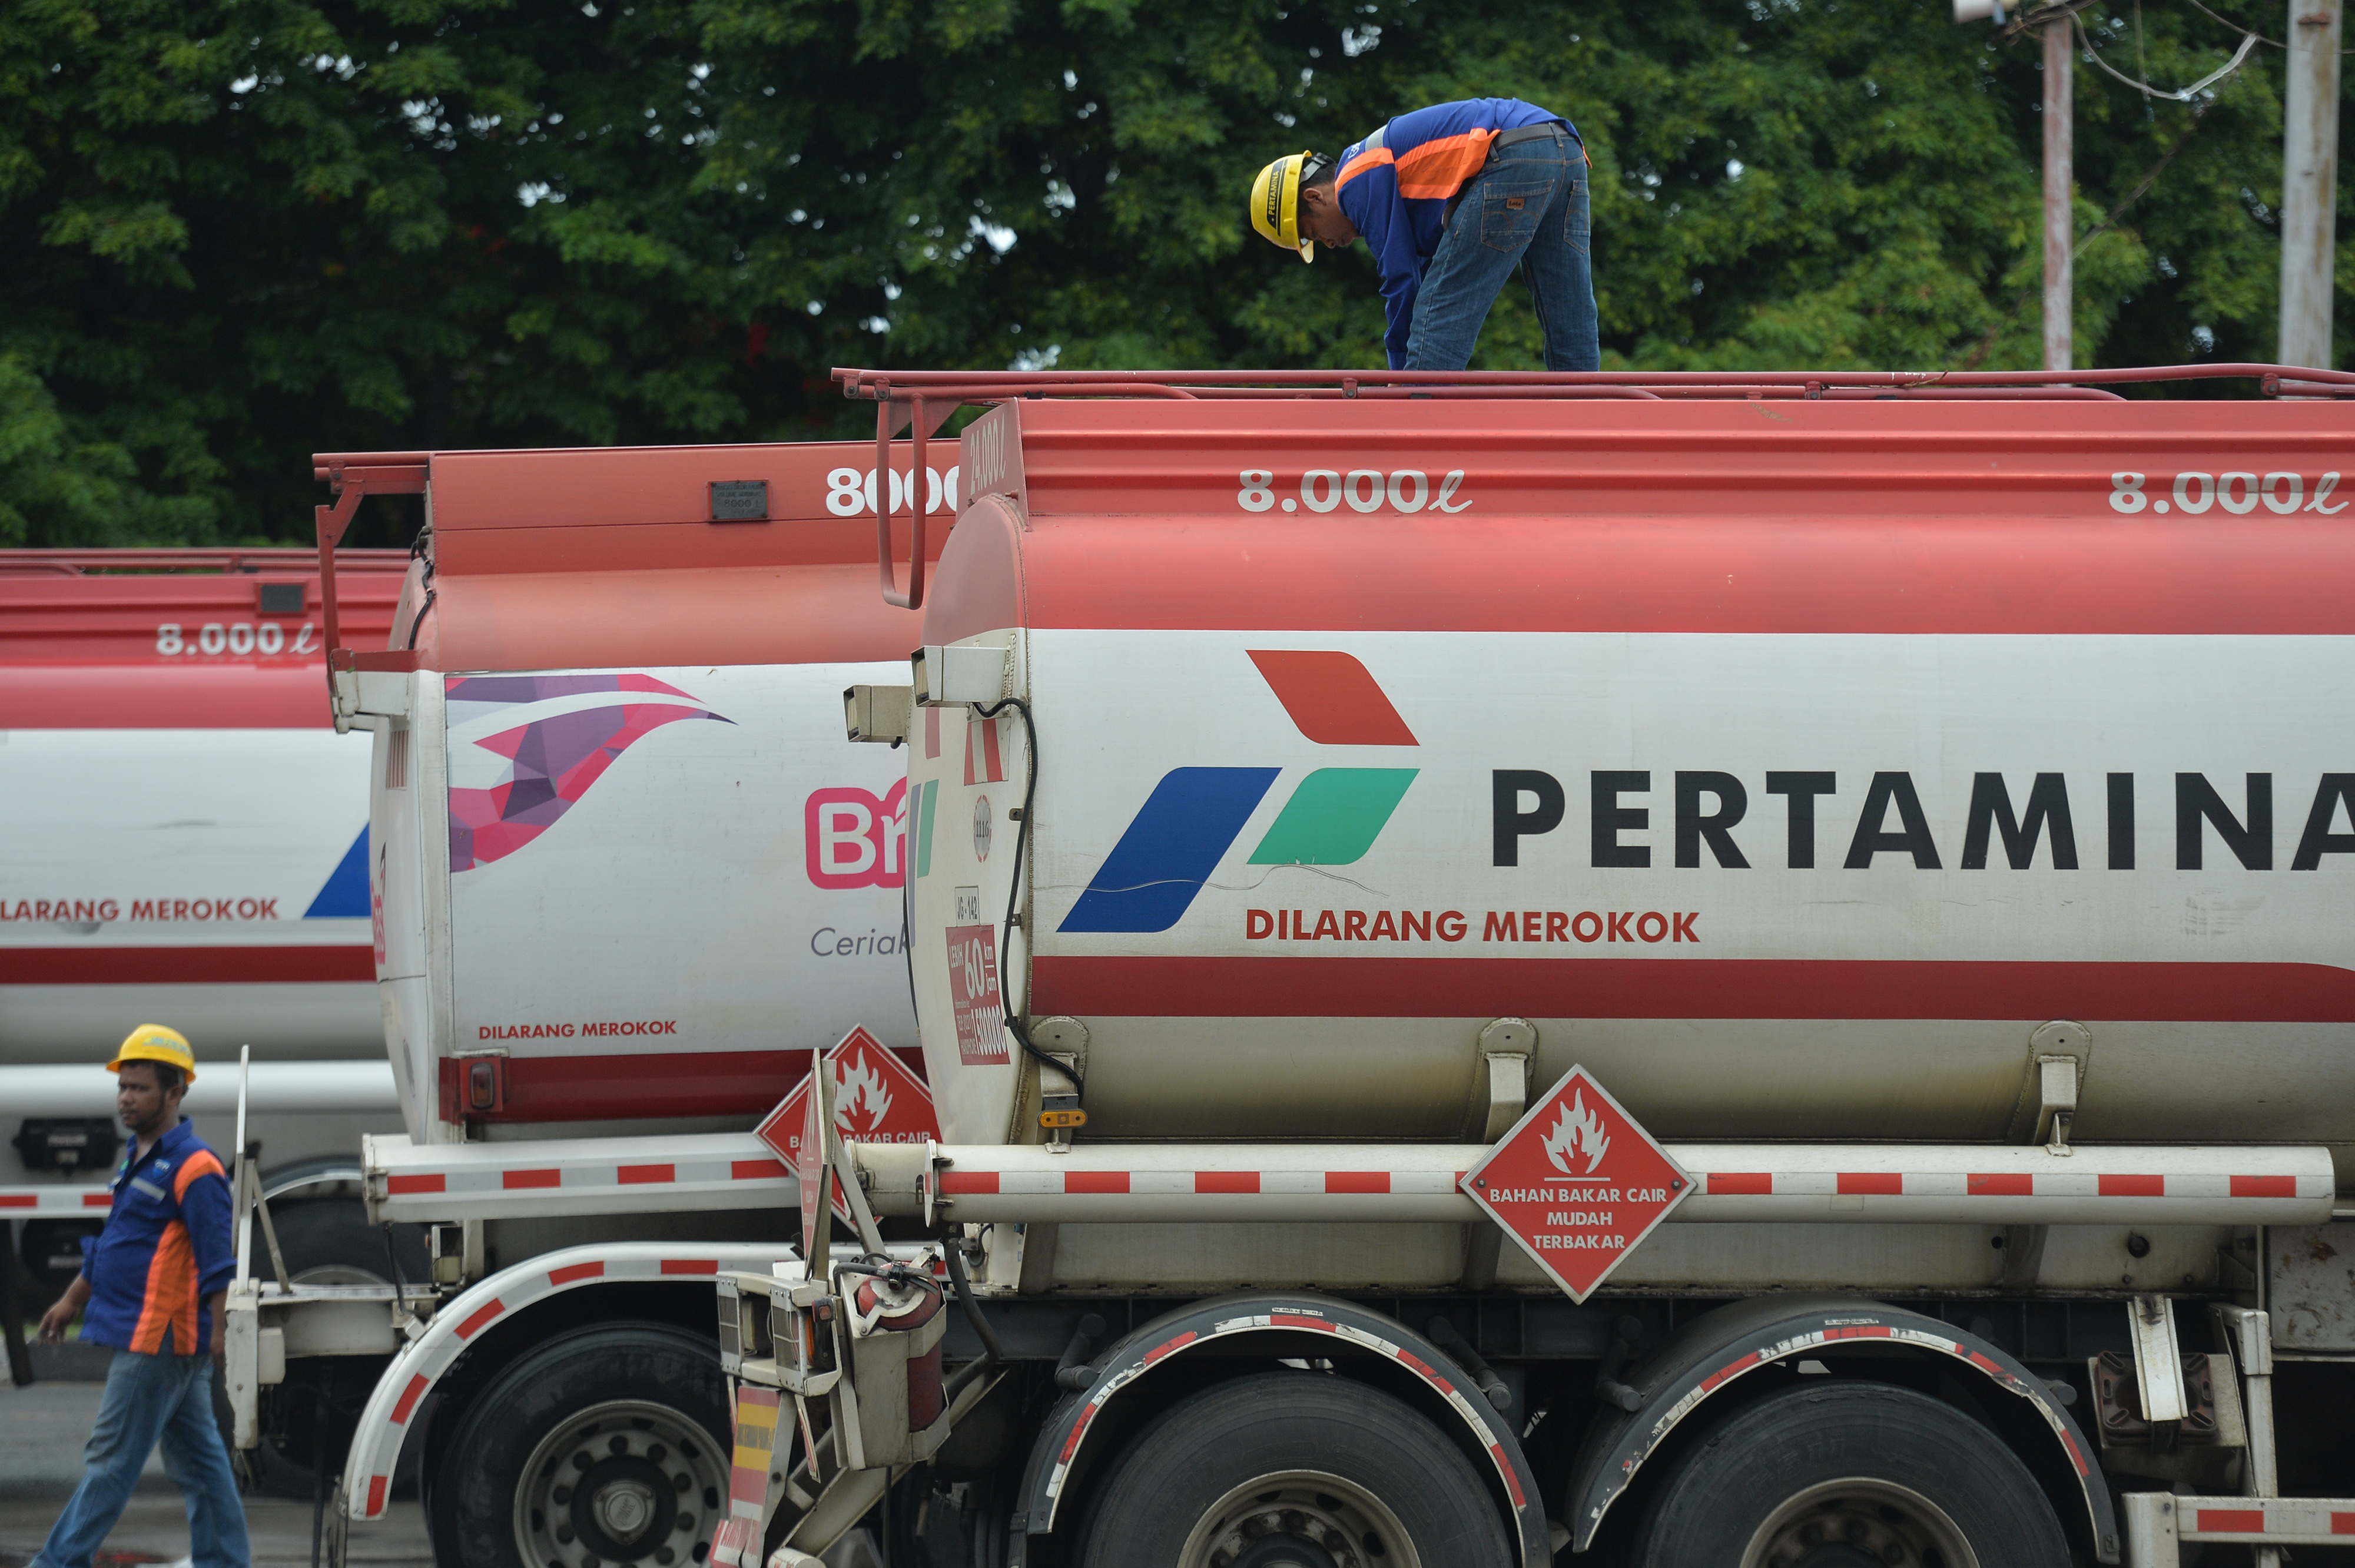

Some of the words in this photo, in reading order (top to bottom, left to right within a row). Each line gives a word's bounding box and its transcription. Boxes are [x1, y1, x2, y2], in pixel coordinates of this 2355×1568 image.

[1268, 170, 1280, 216] PERTAMINA
[724, 499, 751, 508] 8000
[1492, 769, 2355, 871] PERTAMINA
[0, 899, 120, 921] LARANG
[131, 897, 279, 921] MEROKOK
[1246, 909, 1468, 943] DILARANG
[1482, 910, 1700, 943] MEROKOK
[983, 942, 994, 960] km
[949, 943, 964, 969] LEBIH
[964, 937, 985, 999] 60
[479, 1023, 576, 1040] DILARANG
[581, 1020, 677, 1037] MEROKOK
[1490, 1188, 1554, 1202] BAHAN
[1558, 1188, 1621, 1202] BAKAR
[1626, 1188, 1667, 1202] CAIR
[1546, 1212, 1613, 1226] MUDAH
[1533, 1235, 1626, 1249] TERBAKAR
